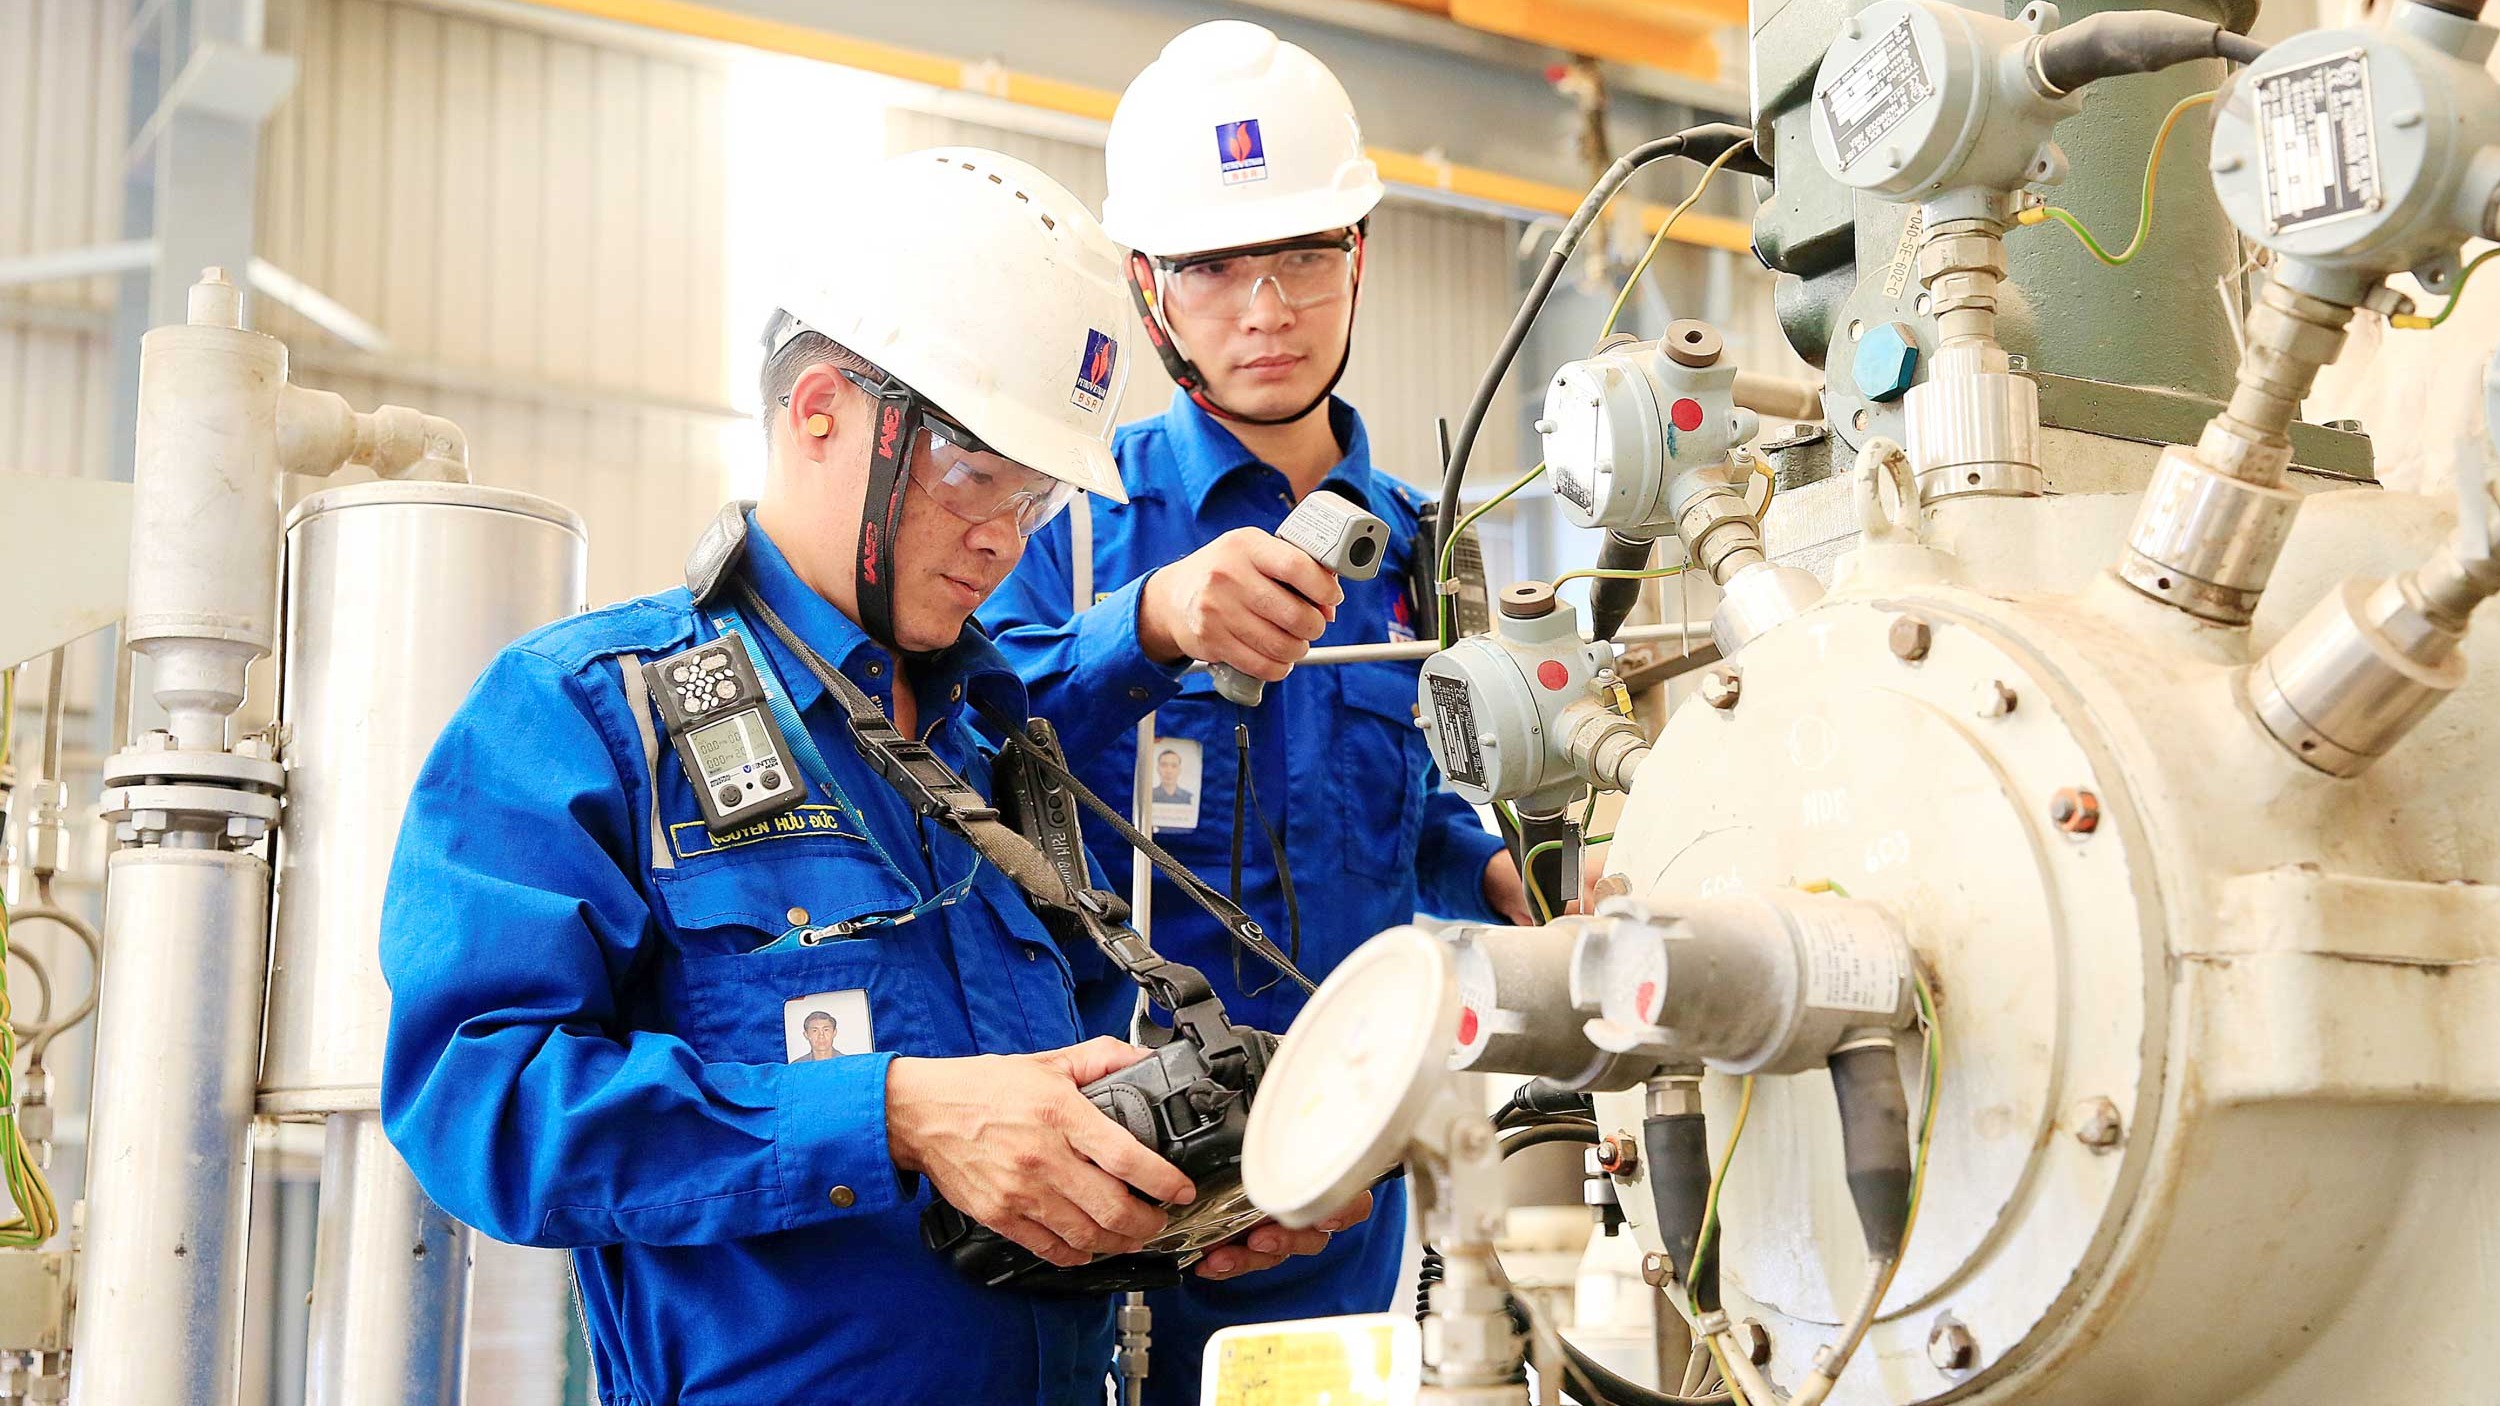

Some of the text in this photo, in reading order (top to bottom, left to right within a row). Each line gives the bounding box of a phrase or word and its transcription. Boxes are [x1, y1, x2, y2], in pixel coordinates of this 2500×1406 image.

[1078, 392, 1098, 409] BSR
[878, 405, 900, 460] 3M
[863, 521, 879, 585] 3M
